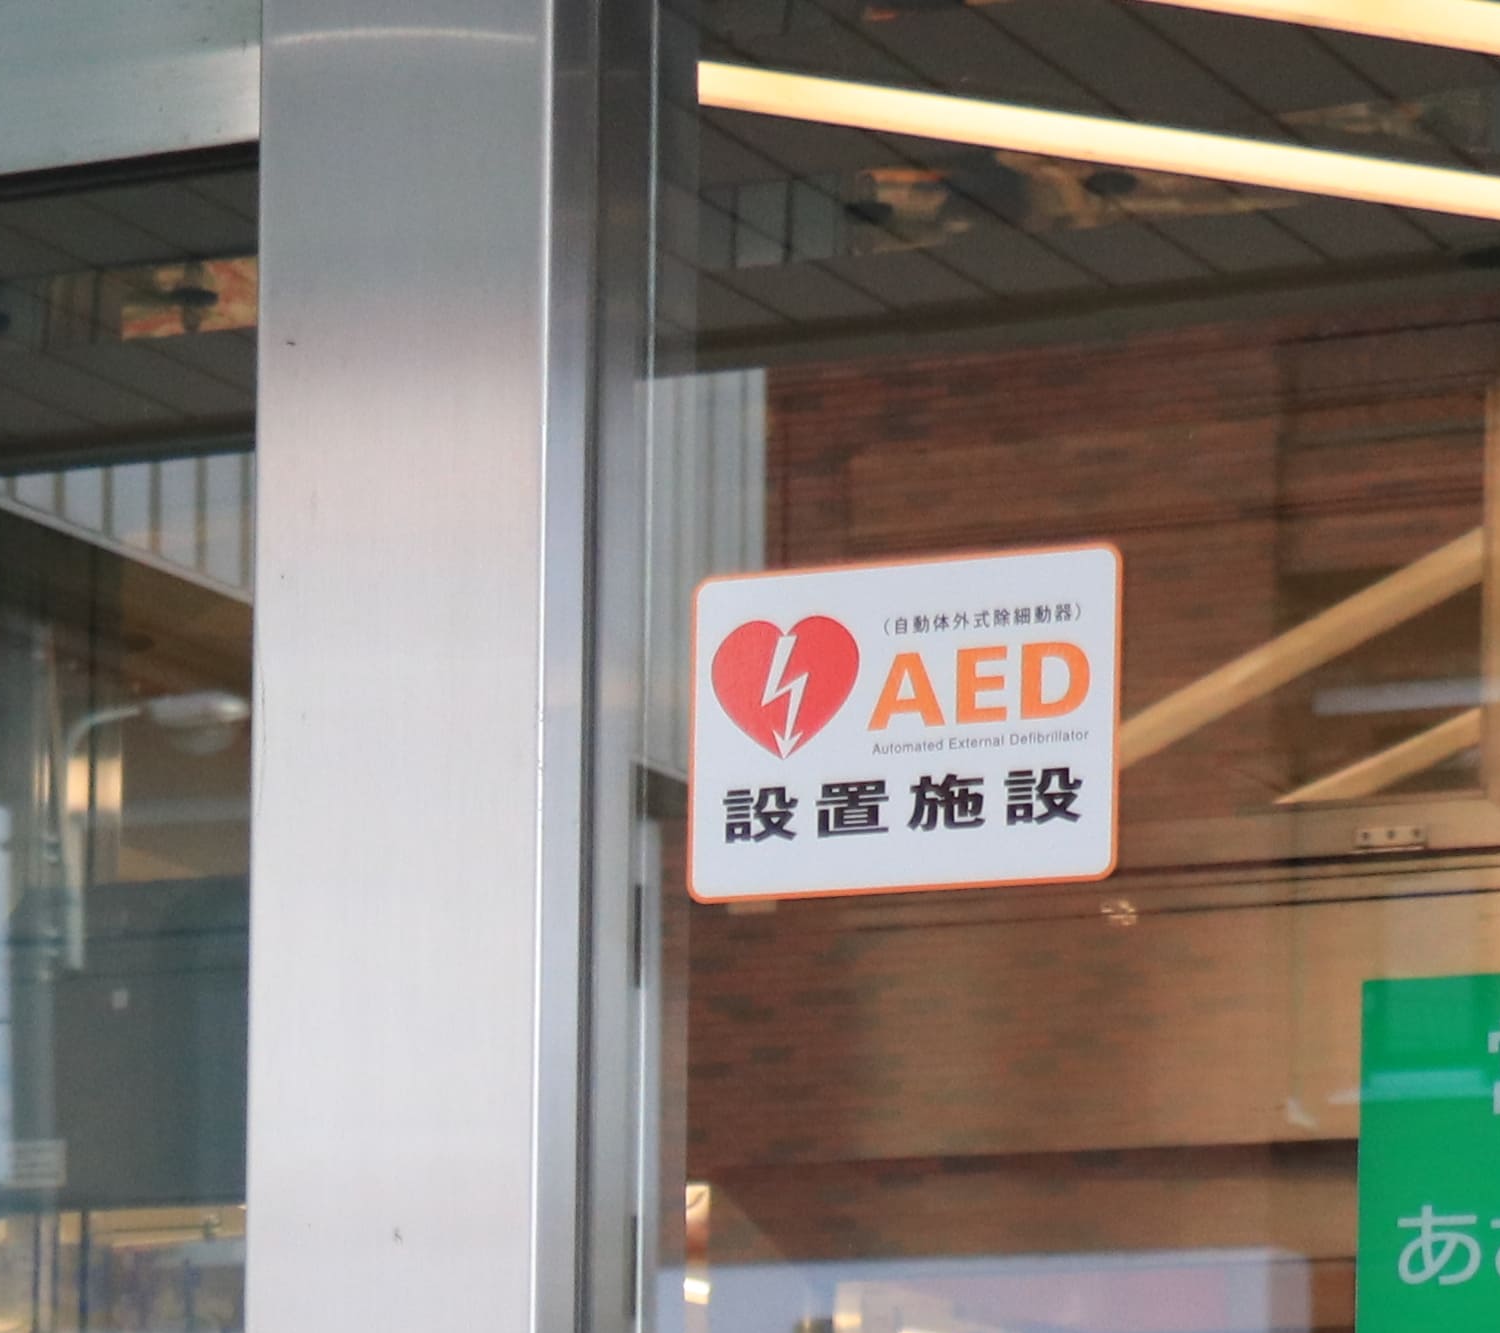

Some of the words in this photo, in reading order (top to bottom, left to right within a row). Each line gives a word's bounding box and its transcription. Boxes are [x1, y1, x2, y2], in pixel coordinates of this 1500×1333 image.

[866, 640, 1091, 732] AED
[871, 737, 946, 757] Automated
[948, 733, 1005, 752] External
[1009, 727, 1090, 748] Defibrillator
[722, 765, 1083, 844] 設置施設
